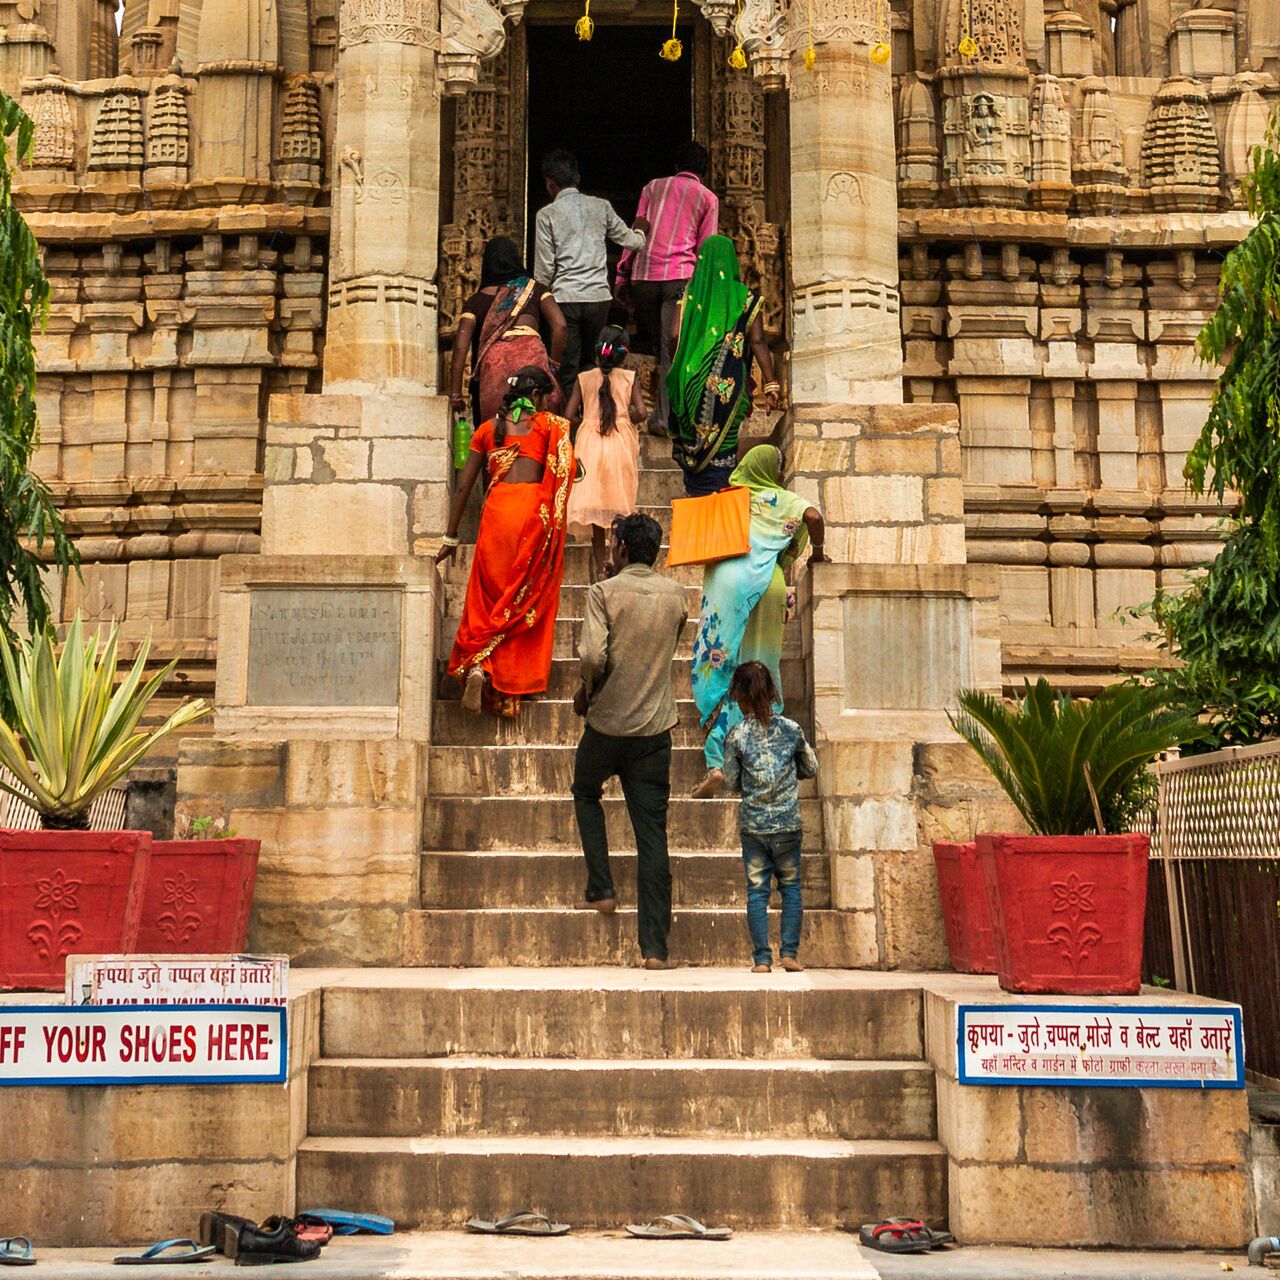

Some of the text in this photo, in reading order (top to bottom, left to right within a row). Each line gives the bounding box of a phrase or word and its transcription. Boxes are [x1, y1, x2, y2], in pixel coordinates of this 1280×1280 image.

[43, 1025, 106, 1063] YOUR
[119, 1024, 196, 1063] SHOES
[207, 1024, 270, 1061] HERE
[1119, 1026, 1129, 1048] व
[1135, 1018, 1160, 1048] बेल्ट
[1031, 1059, 1037, 1071] व
